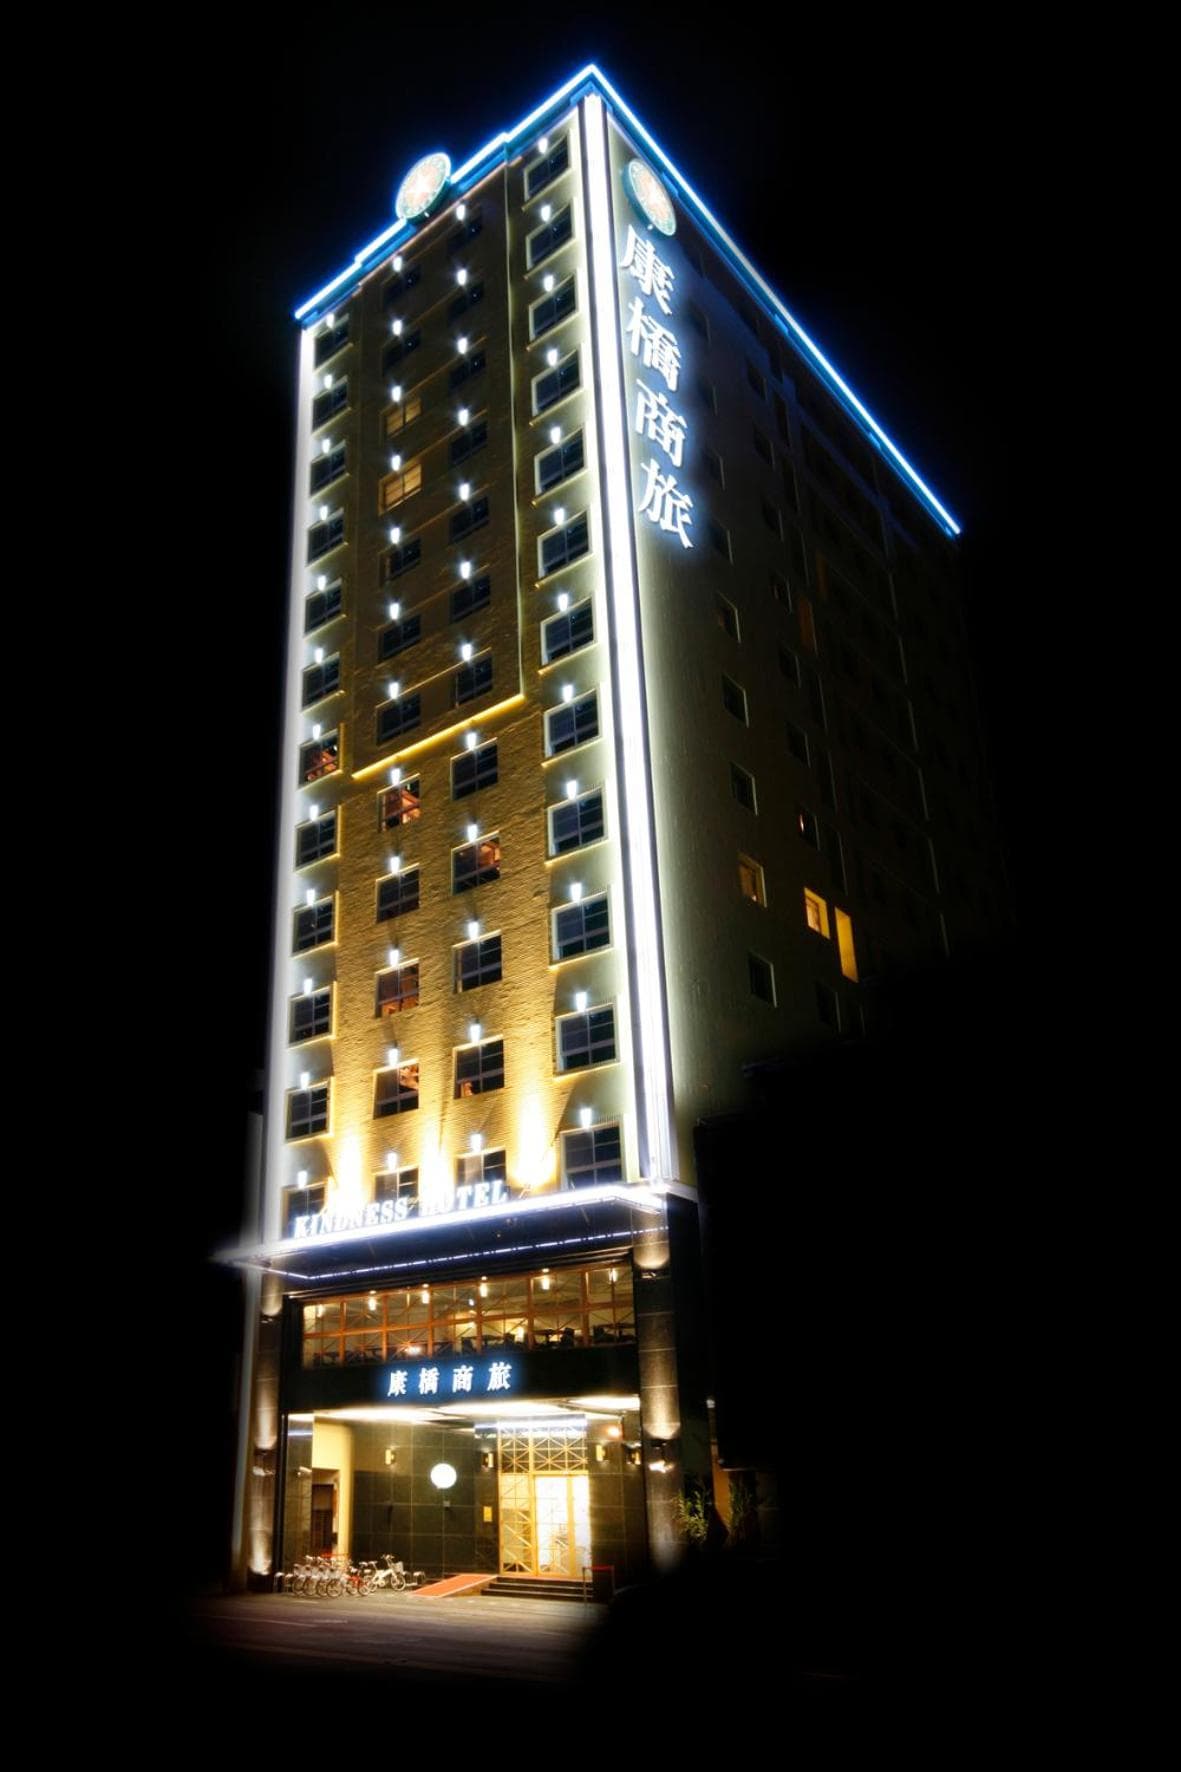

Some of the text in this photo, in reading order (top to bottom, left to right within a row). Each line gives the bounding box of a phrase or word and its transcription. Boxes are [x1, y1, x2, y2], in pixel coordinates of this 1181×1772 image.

[620, 225, 693, 548] 康橋商旅
[294, 1197, 409, 1238] KINDNESS
[388, 1362, 512, 1396] 康橋商旅
